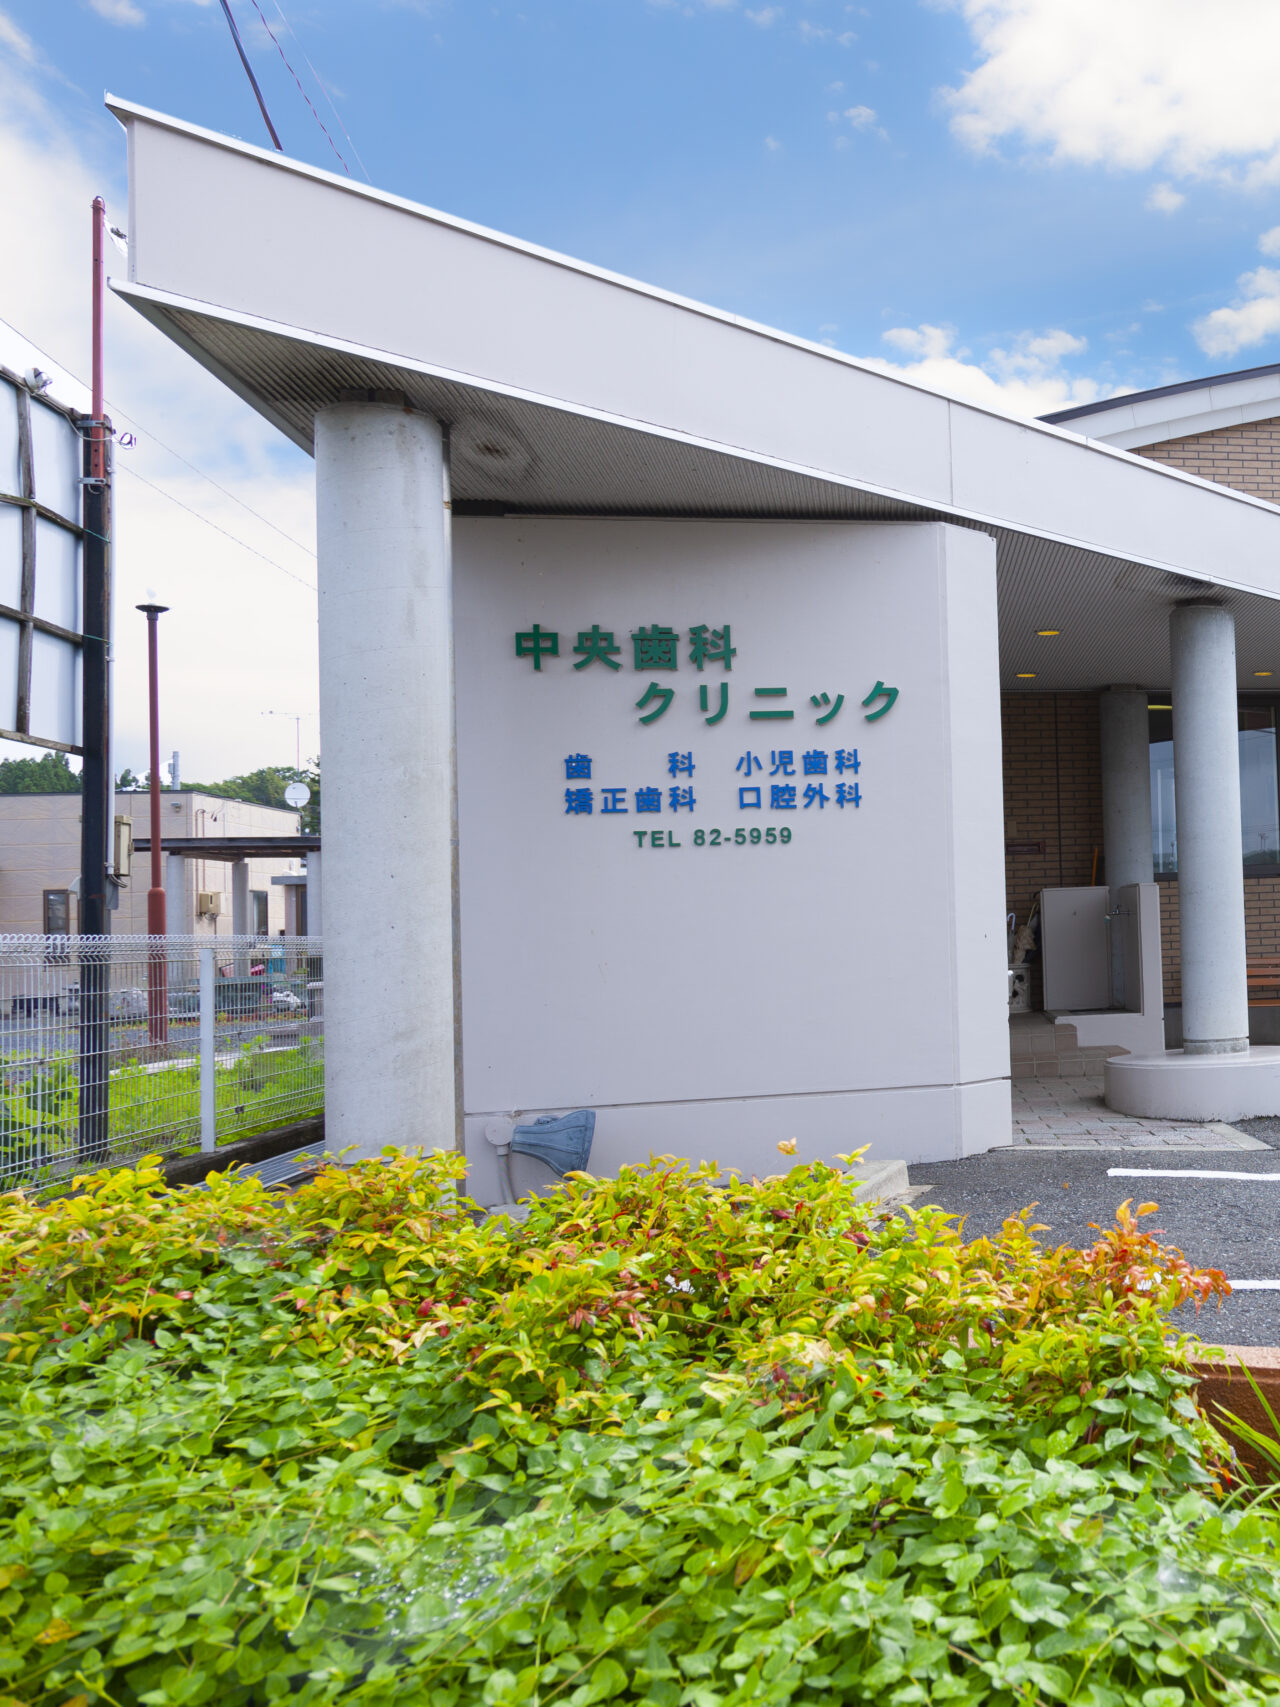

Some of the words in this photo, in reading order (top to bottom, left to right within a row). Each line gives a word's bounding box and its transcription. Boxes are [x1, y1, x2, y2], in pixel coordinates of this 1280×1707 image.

[515, 623, 738, 671] 中央歯科
[635, 681, 900, 726] クリニック
[736, 748, 862, 778] 小児歯科
[565, 786, 697, 815] 矯正歯科
[738, 782, 863, 810] 口腔外科
[633, 830, 681, 848] TEL
[694, 827, 792, 846] 82-5959
